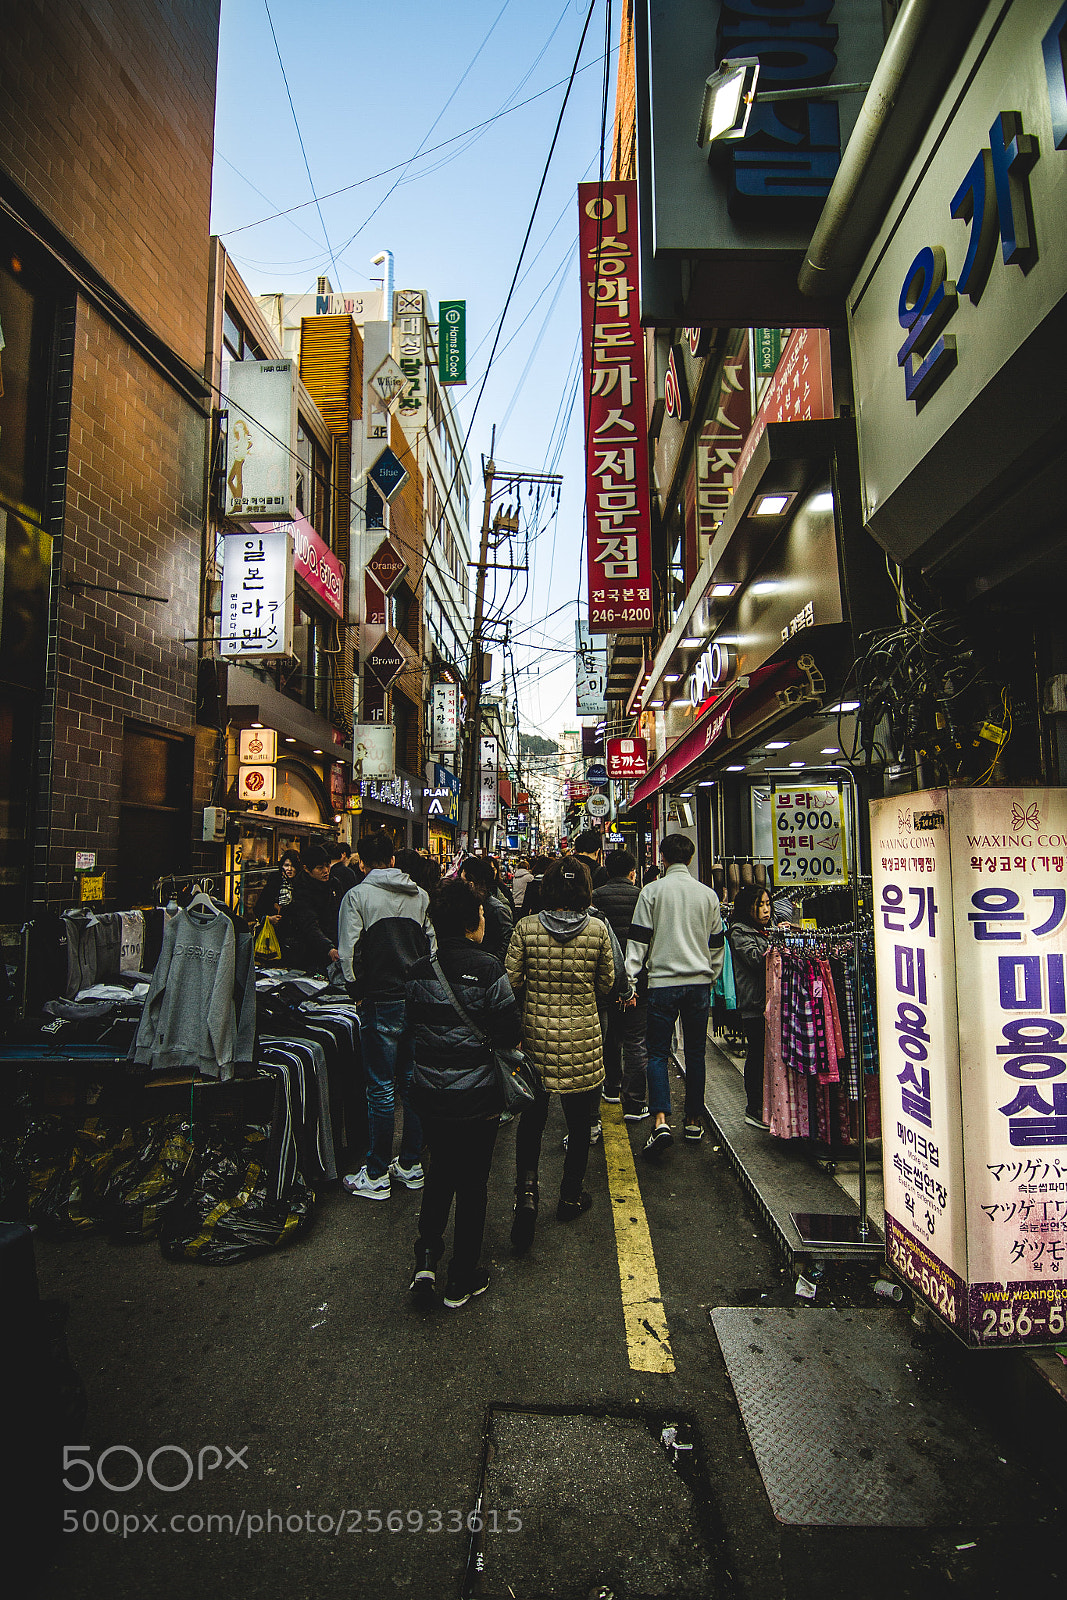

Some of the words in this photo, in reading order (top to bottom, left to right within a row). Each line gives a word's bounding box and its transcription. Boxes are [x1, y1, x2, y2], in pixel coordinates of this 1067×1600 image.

[449, 325, 460, 347] Hams
[449, 356, 460, 378] Cook
[377, 377, 401, 387] White
[373, 426, 387, 437] 4F
[379, 468, 398, 477] Blue
[371, 560, 403, 570] Orange
[240, 539, 266, 649] 일본라멘
[591, 588, 651, 602] 전국본점
[371, 612, 386, 623] 2F
[592, 607, 651, 623] 246-4200
[371, 656, 400, 666] Brown
[370, 709, 384, 721] 1F
[609, 755, 646, 769] 돈까스
[423, 788, 449, 797] PLAN
[776, 793, 812, 810] 브라
[778, 834, 815, 856] 팬티
[879, 837, 909, 849] WAXING
[909, 836, 935, 848] COWA
[966, 834, 1033, 848] WAXING
[881, 884, 938, 938] 은가
[894, 944, 933, 1129] 미용실
[995, 954, 1067, 1147] 미용실
[896, 1120, 939, 1169] 메이크업
[893, 1152, 948, 1209] 속눈썹연장
[892, 1236, 957, 1324] 256-5024
